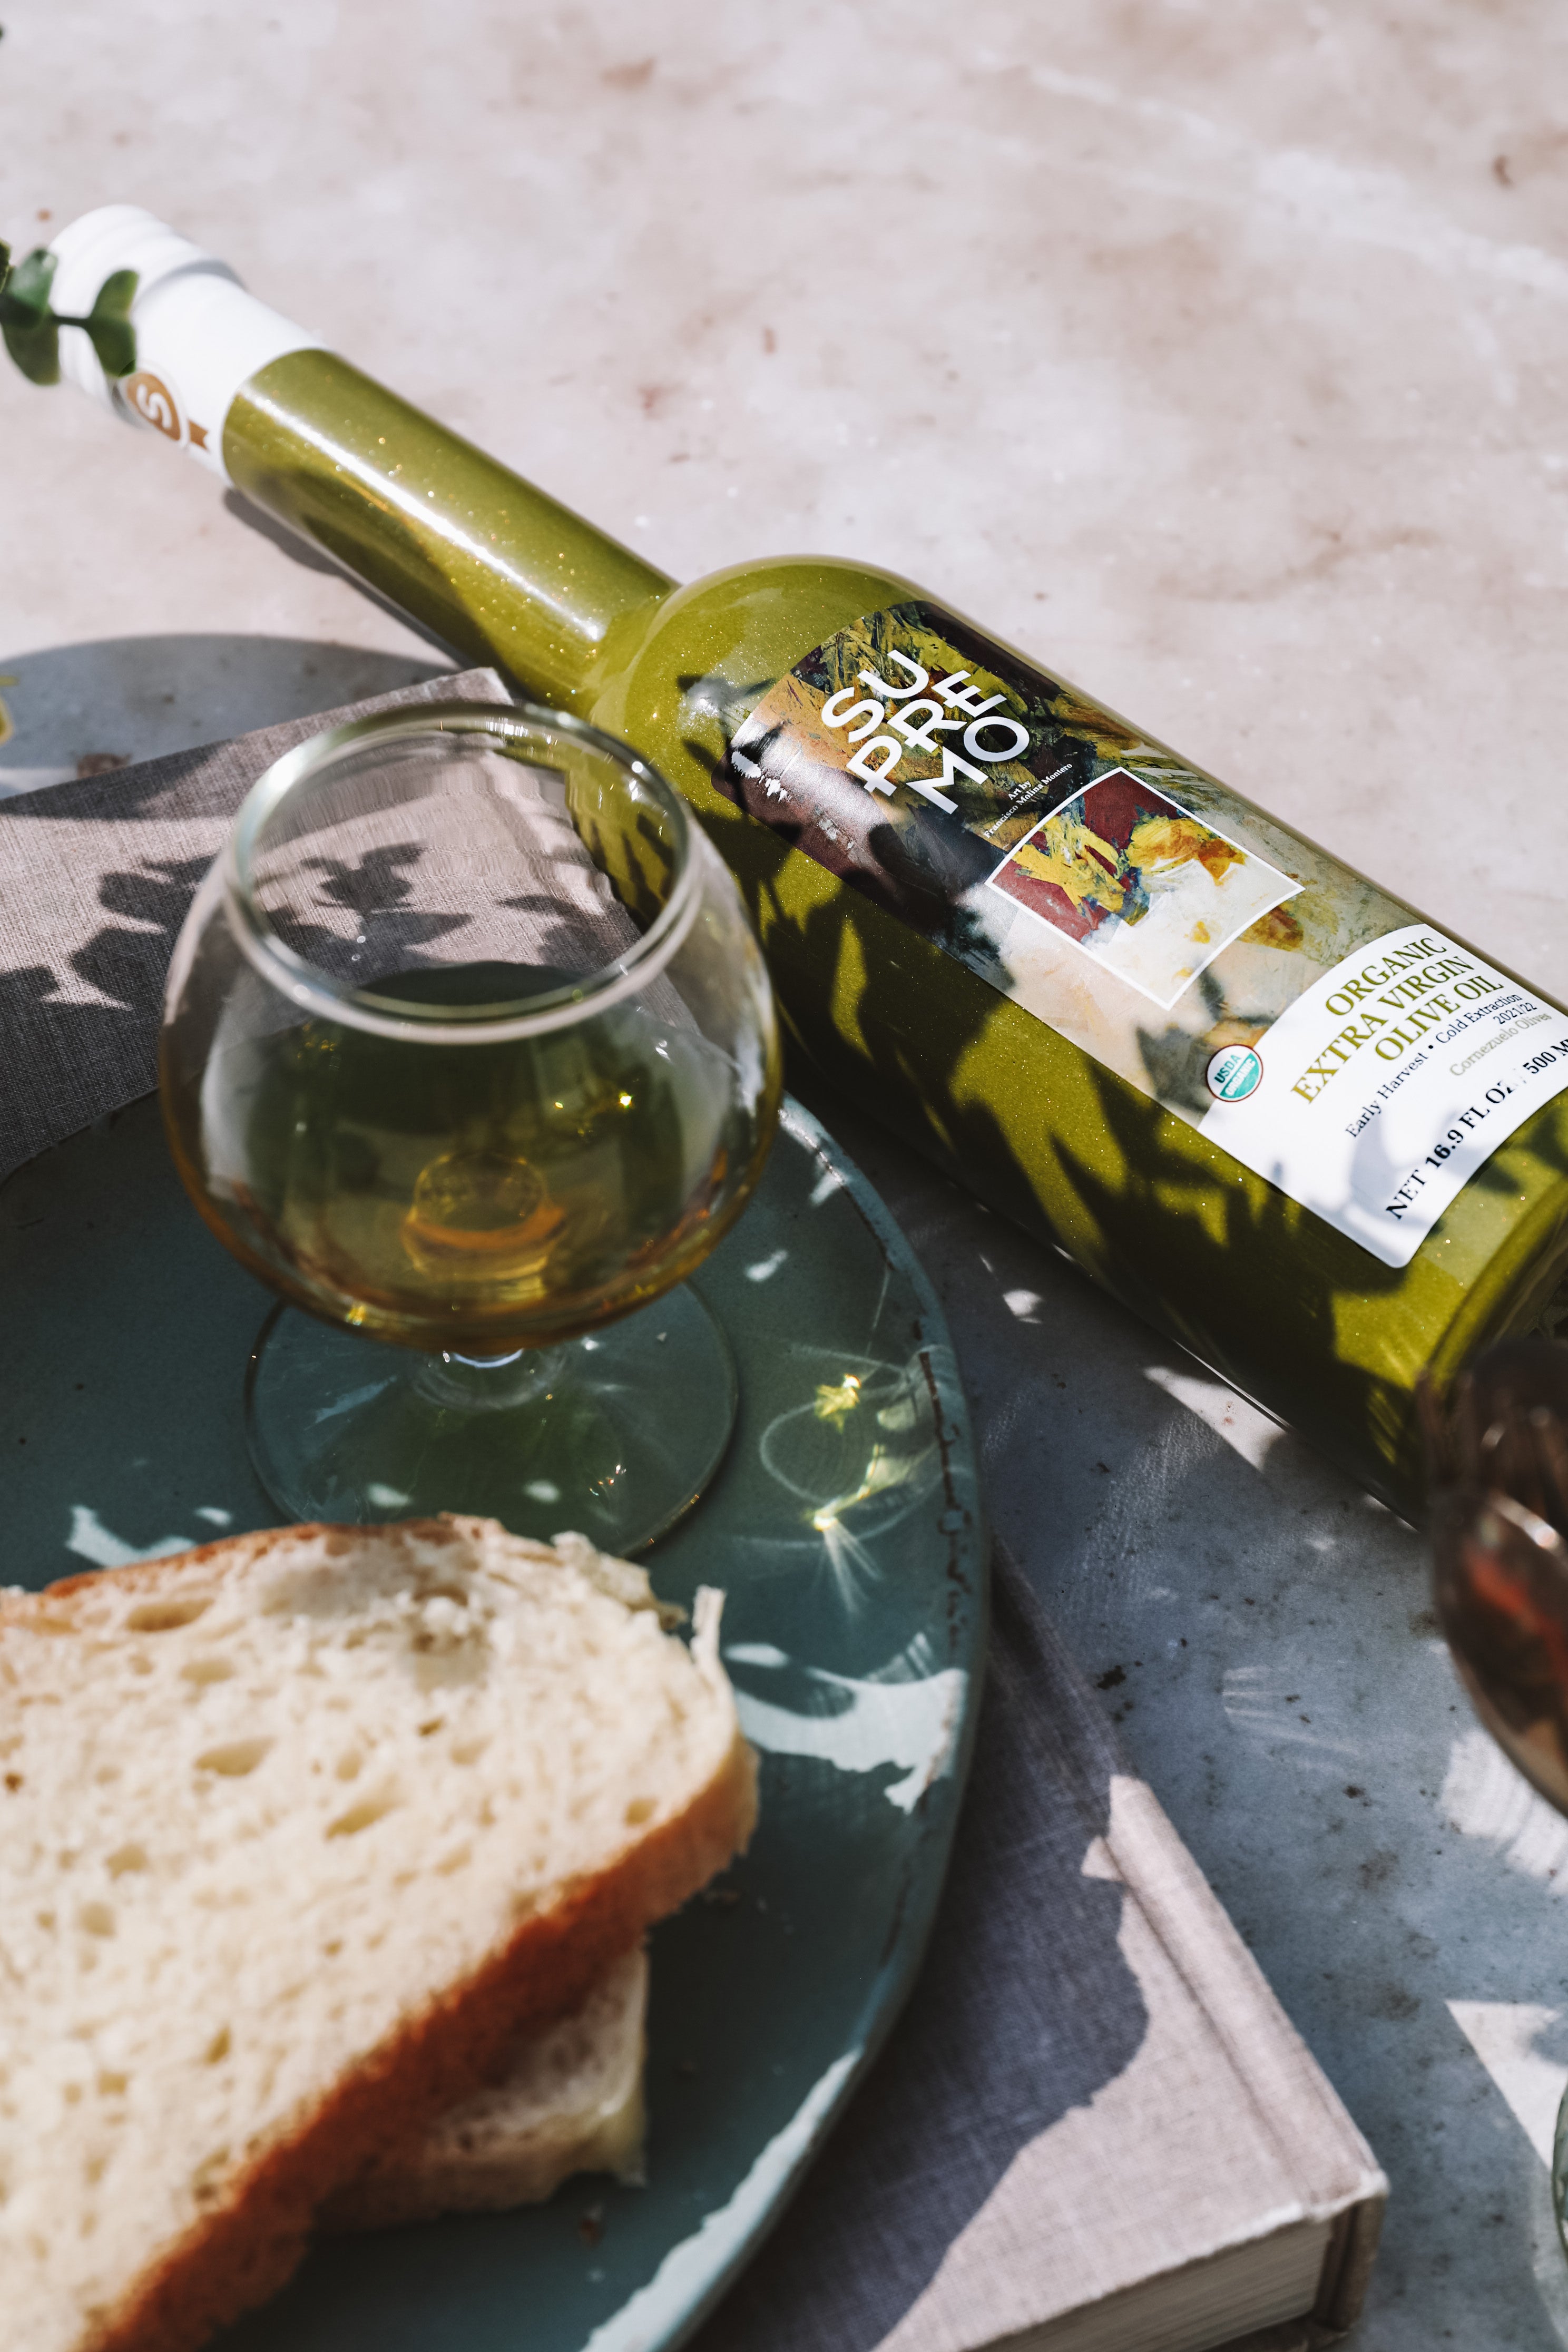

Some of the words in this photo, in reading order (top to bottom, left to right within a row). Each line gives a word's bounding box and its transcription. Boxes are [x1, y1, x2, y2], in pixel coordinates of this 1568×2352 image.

[821, 650, 929, 743] SU
[847, 670, 1007, 797] PRE
[906, 716, 1030, 815] MO
[984, 805, 1018, 839] Francisco
[1016, 783, 1044, 805] Molina
[1041, 763, 1073, 785] Montero
[1008, 787, 1022, 800] Art
[1018, 780, 1032, 791] by
[1326, 938, 1447, 1015] ORGANIC
[1493, 1003, 1537, 1024] 2021/22
[1290, 1013, 1389, 1104] EXTRA
[1377, 956, 1475, 1010] VIRGIN
[1375, 994, 1461, 1060] OLIVE
[1454, 976, 1504, 1000] OIL
[1450, 1028, 1518, 1076] Cornezuelo
[1515, 1013, 1552, 1030] Olives
[1214, 1055, 1241, 1083] USDA
[1225, 1058, 1256, 1096] ORGANIC
[1346, 1101, 1381, 1138] Early
[1377, 1052, 1428, 1099] Harvest
[1436, 1019, 1468, 1043] Cold
[1464, 994, 1523, 1023] Extraction
[1386, 1169, 1426, 1219] NET
[1425, 1130, 1464, 1168] 16.9
[1458, 1106, 1490, 1129] FL
[1523, 1052, 1556, 1074] 500
